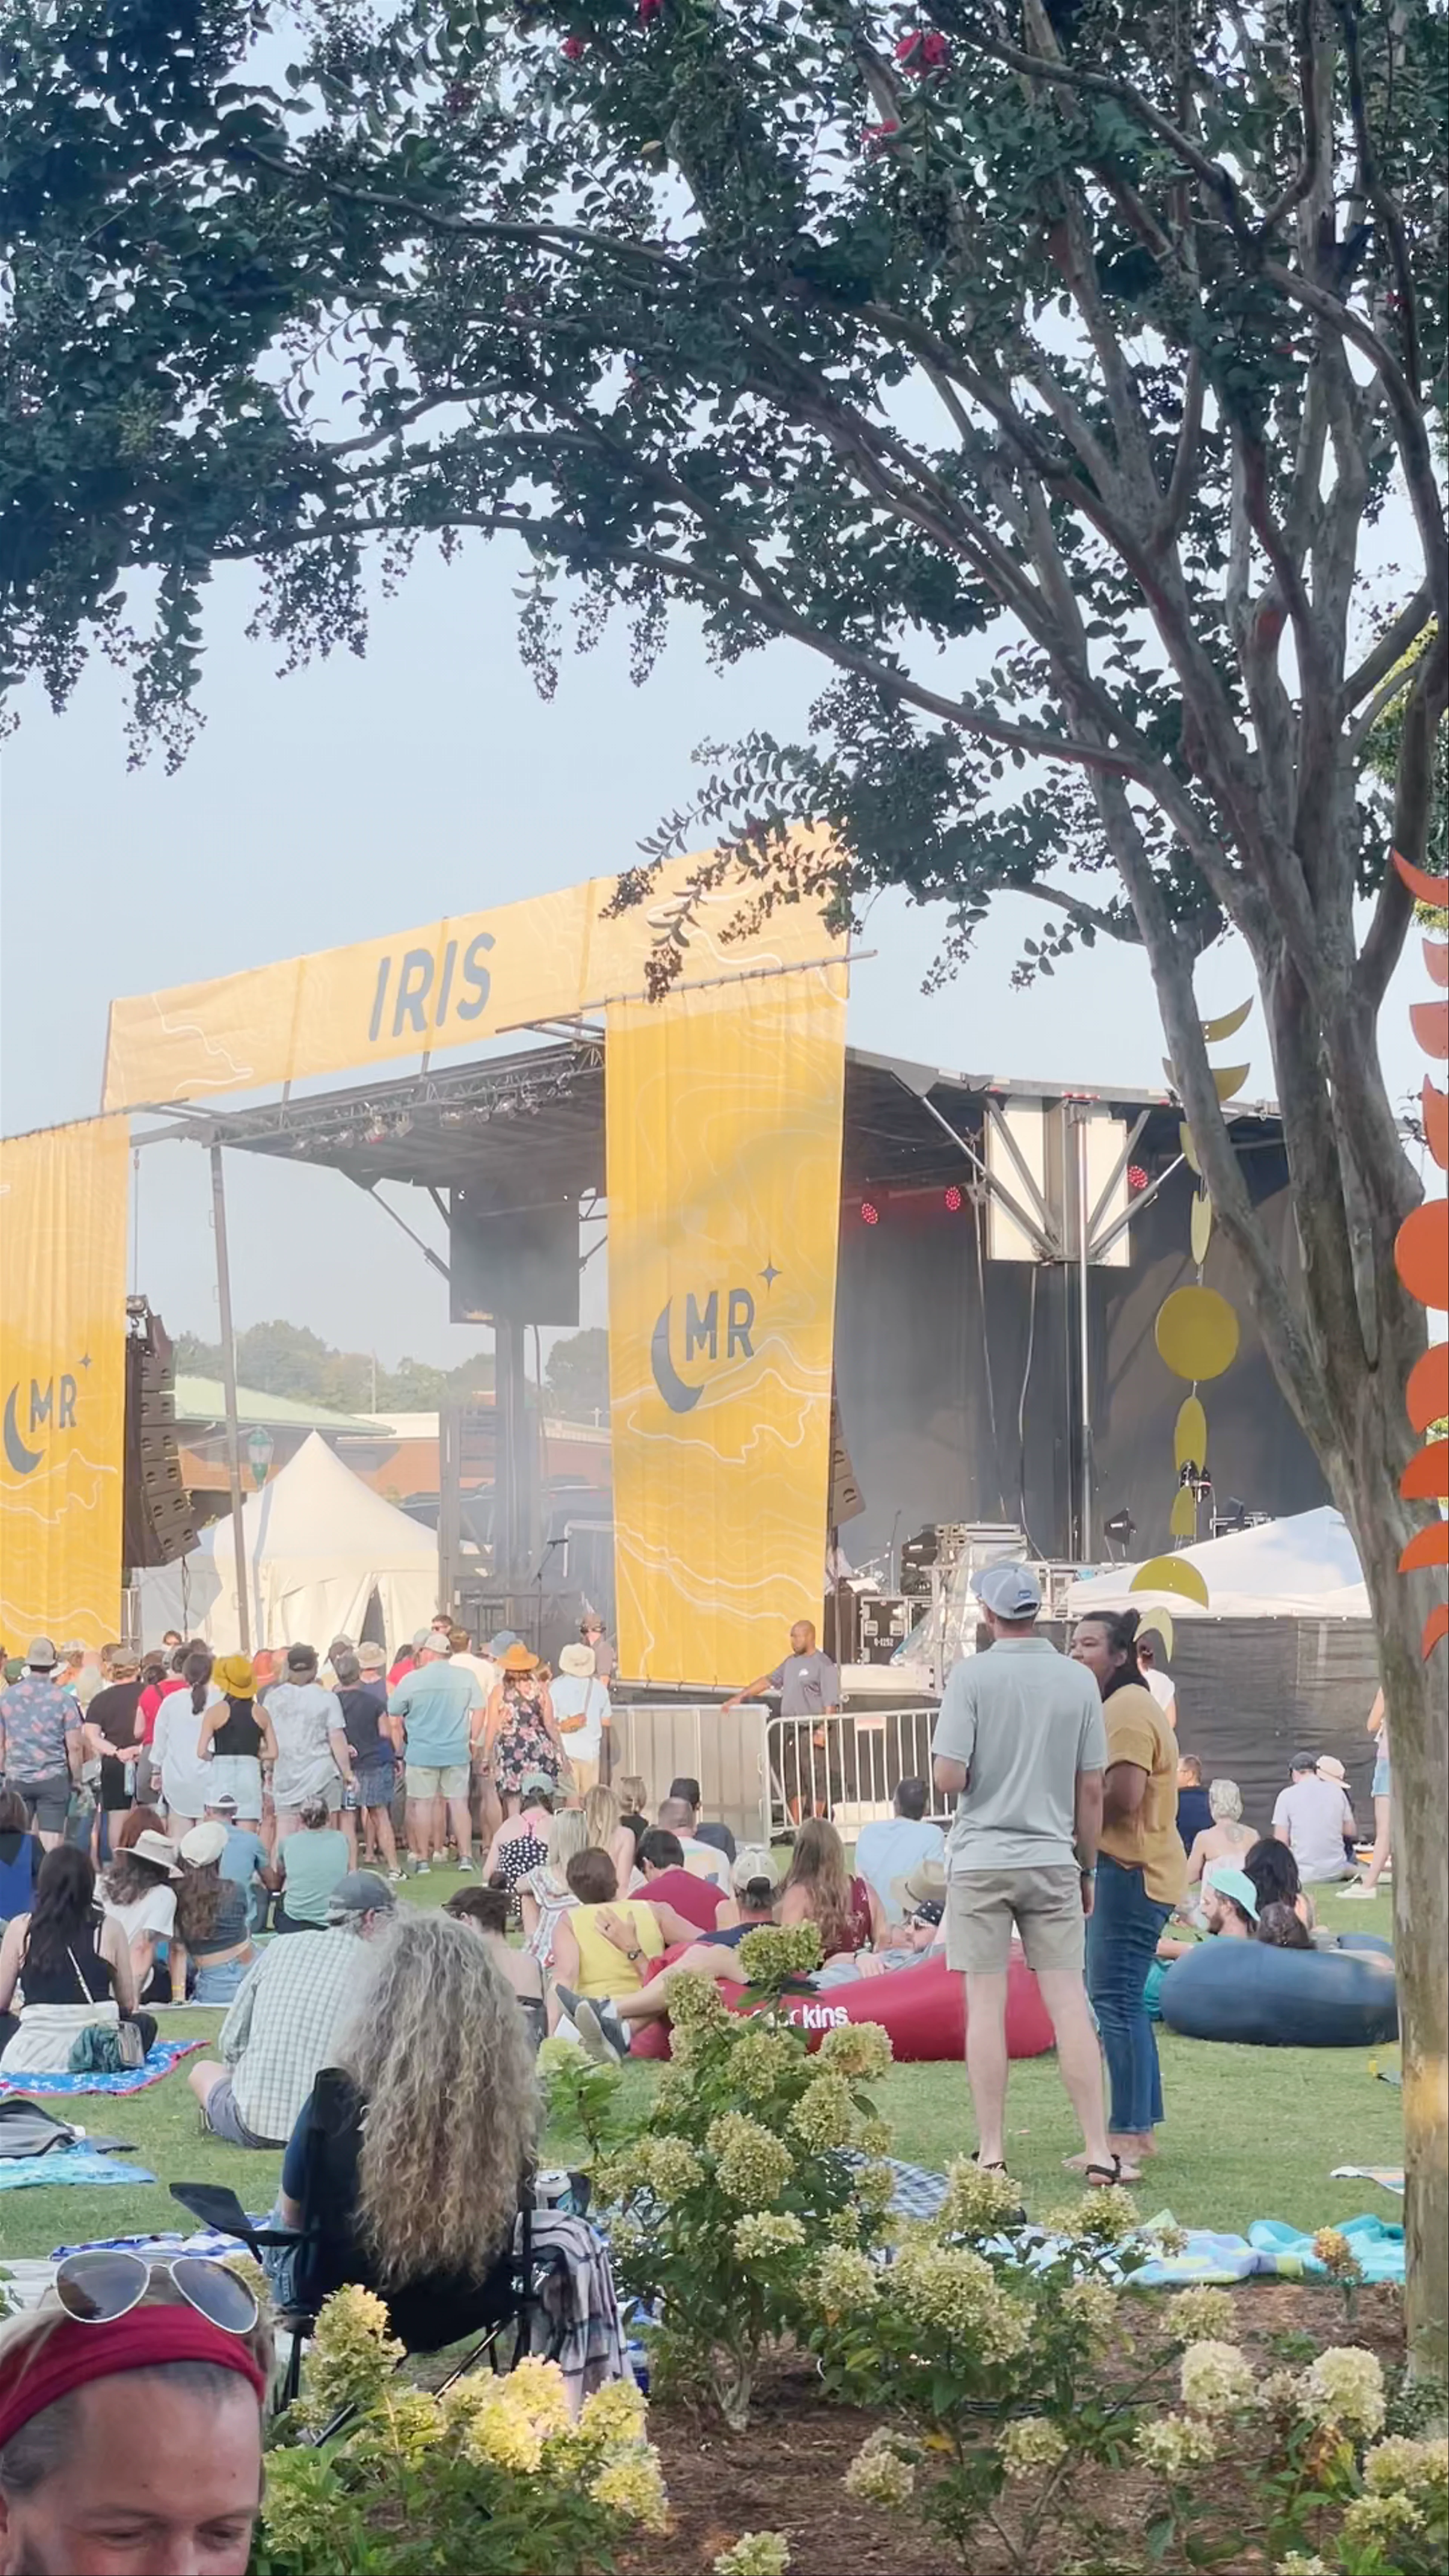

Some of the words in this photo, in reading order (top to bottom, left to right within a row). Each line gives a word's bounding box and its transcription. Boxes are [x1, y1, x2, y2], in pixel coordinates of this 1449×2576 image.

[368, 932, 496, 1041] IRIS
[686, 1287, 755, 1361] MR
[30, 1373, 77, 1433] MR
